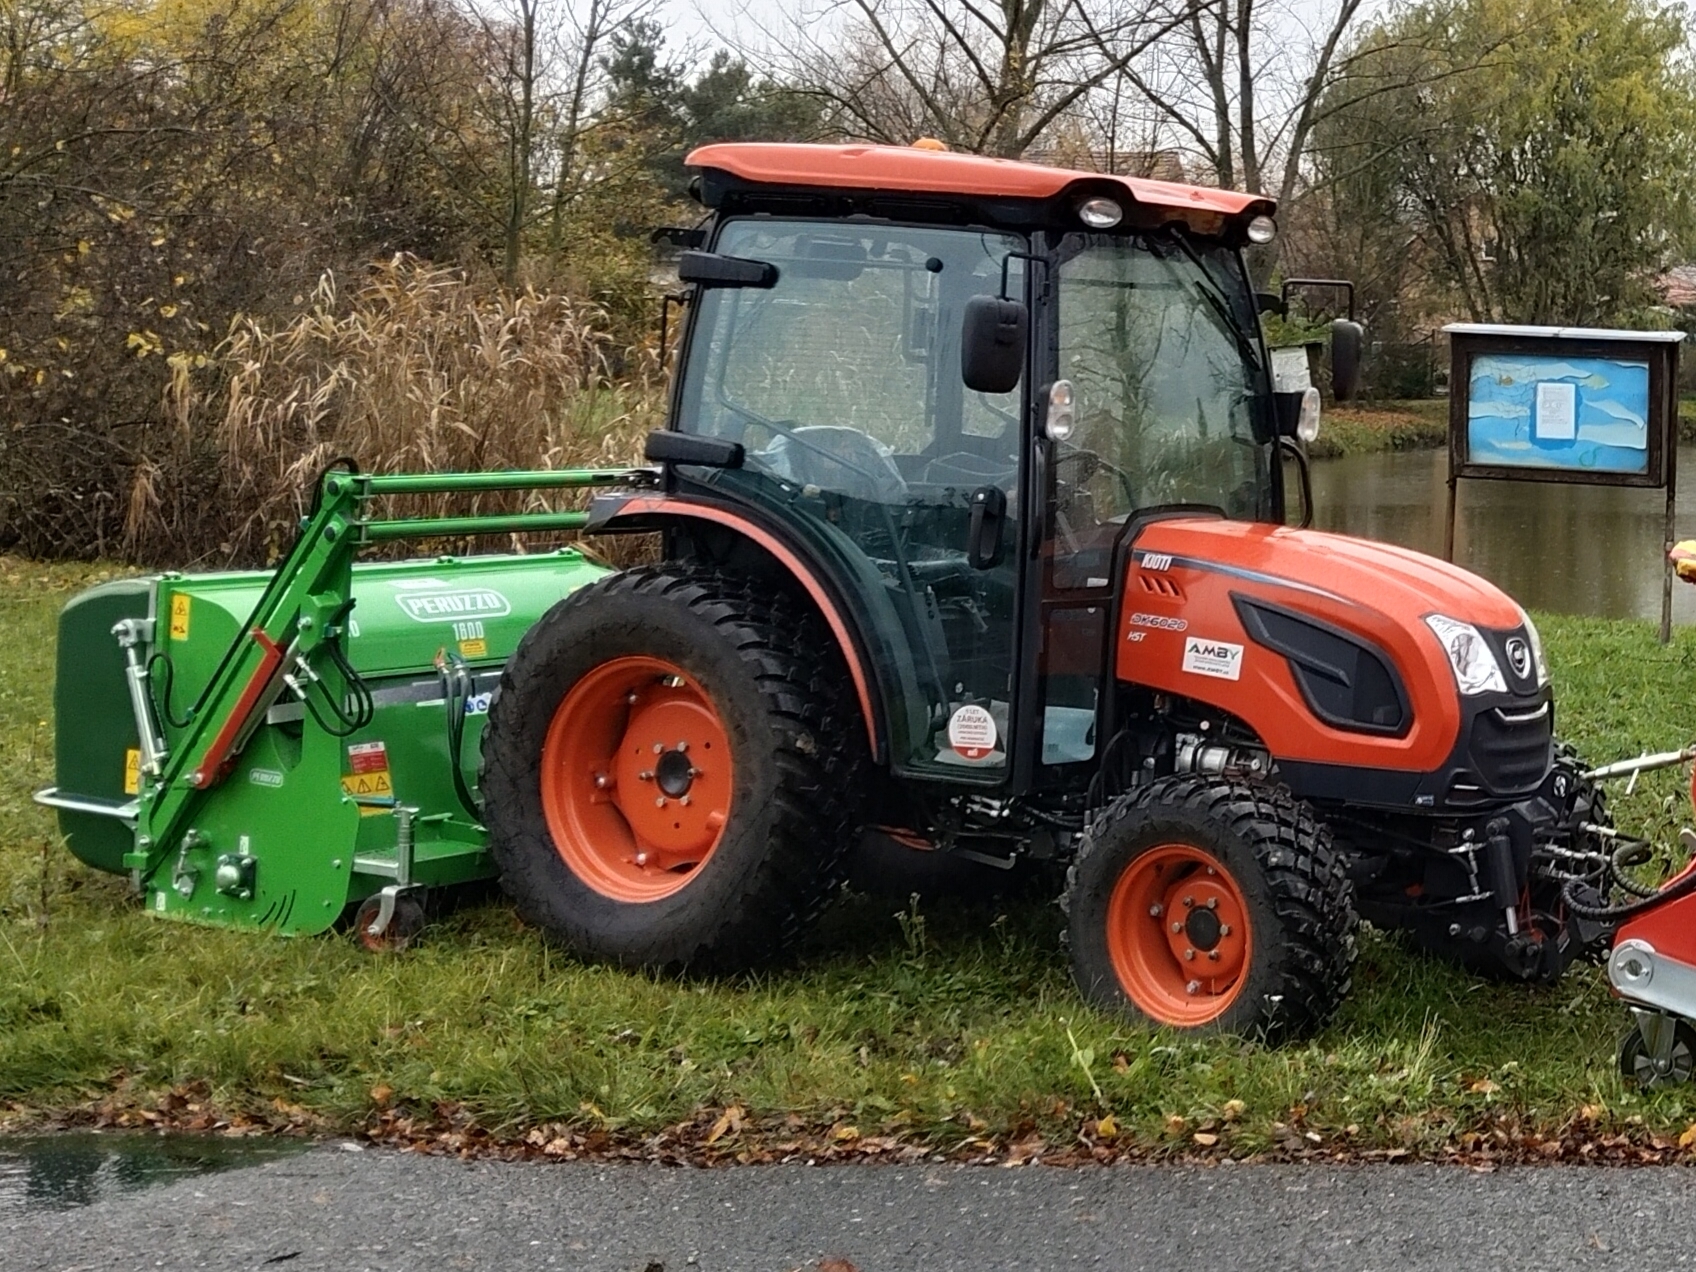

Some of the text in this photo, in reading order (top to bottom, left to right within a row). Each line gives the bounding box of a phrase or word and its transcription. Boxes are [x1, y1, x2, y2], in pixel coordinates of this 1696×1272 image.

[1141, 553, 1172, 571] KIOTI
[406, 593, 502, 614] PERUZZO
[452, 621, 484, 641] 1600
[1130, 613, 1188, 631] DK6020
[1127, 631, 1147, 642] HST
[1187, 642, 1240, 661] AMBY
